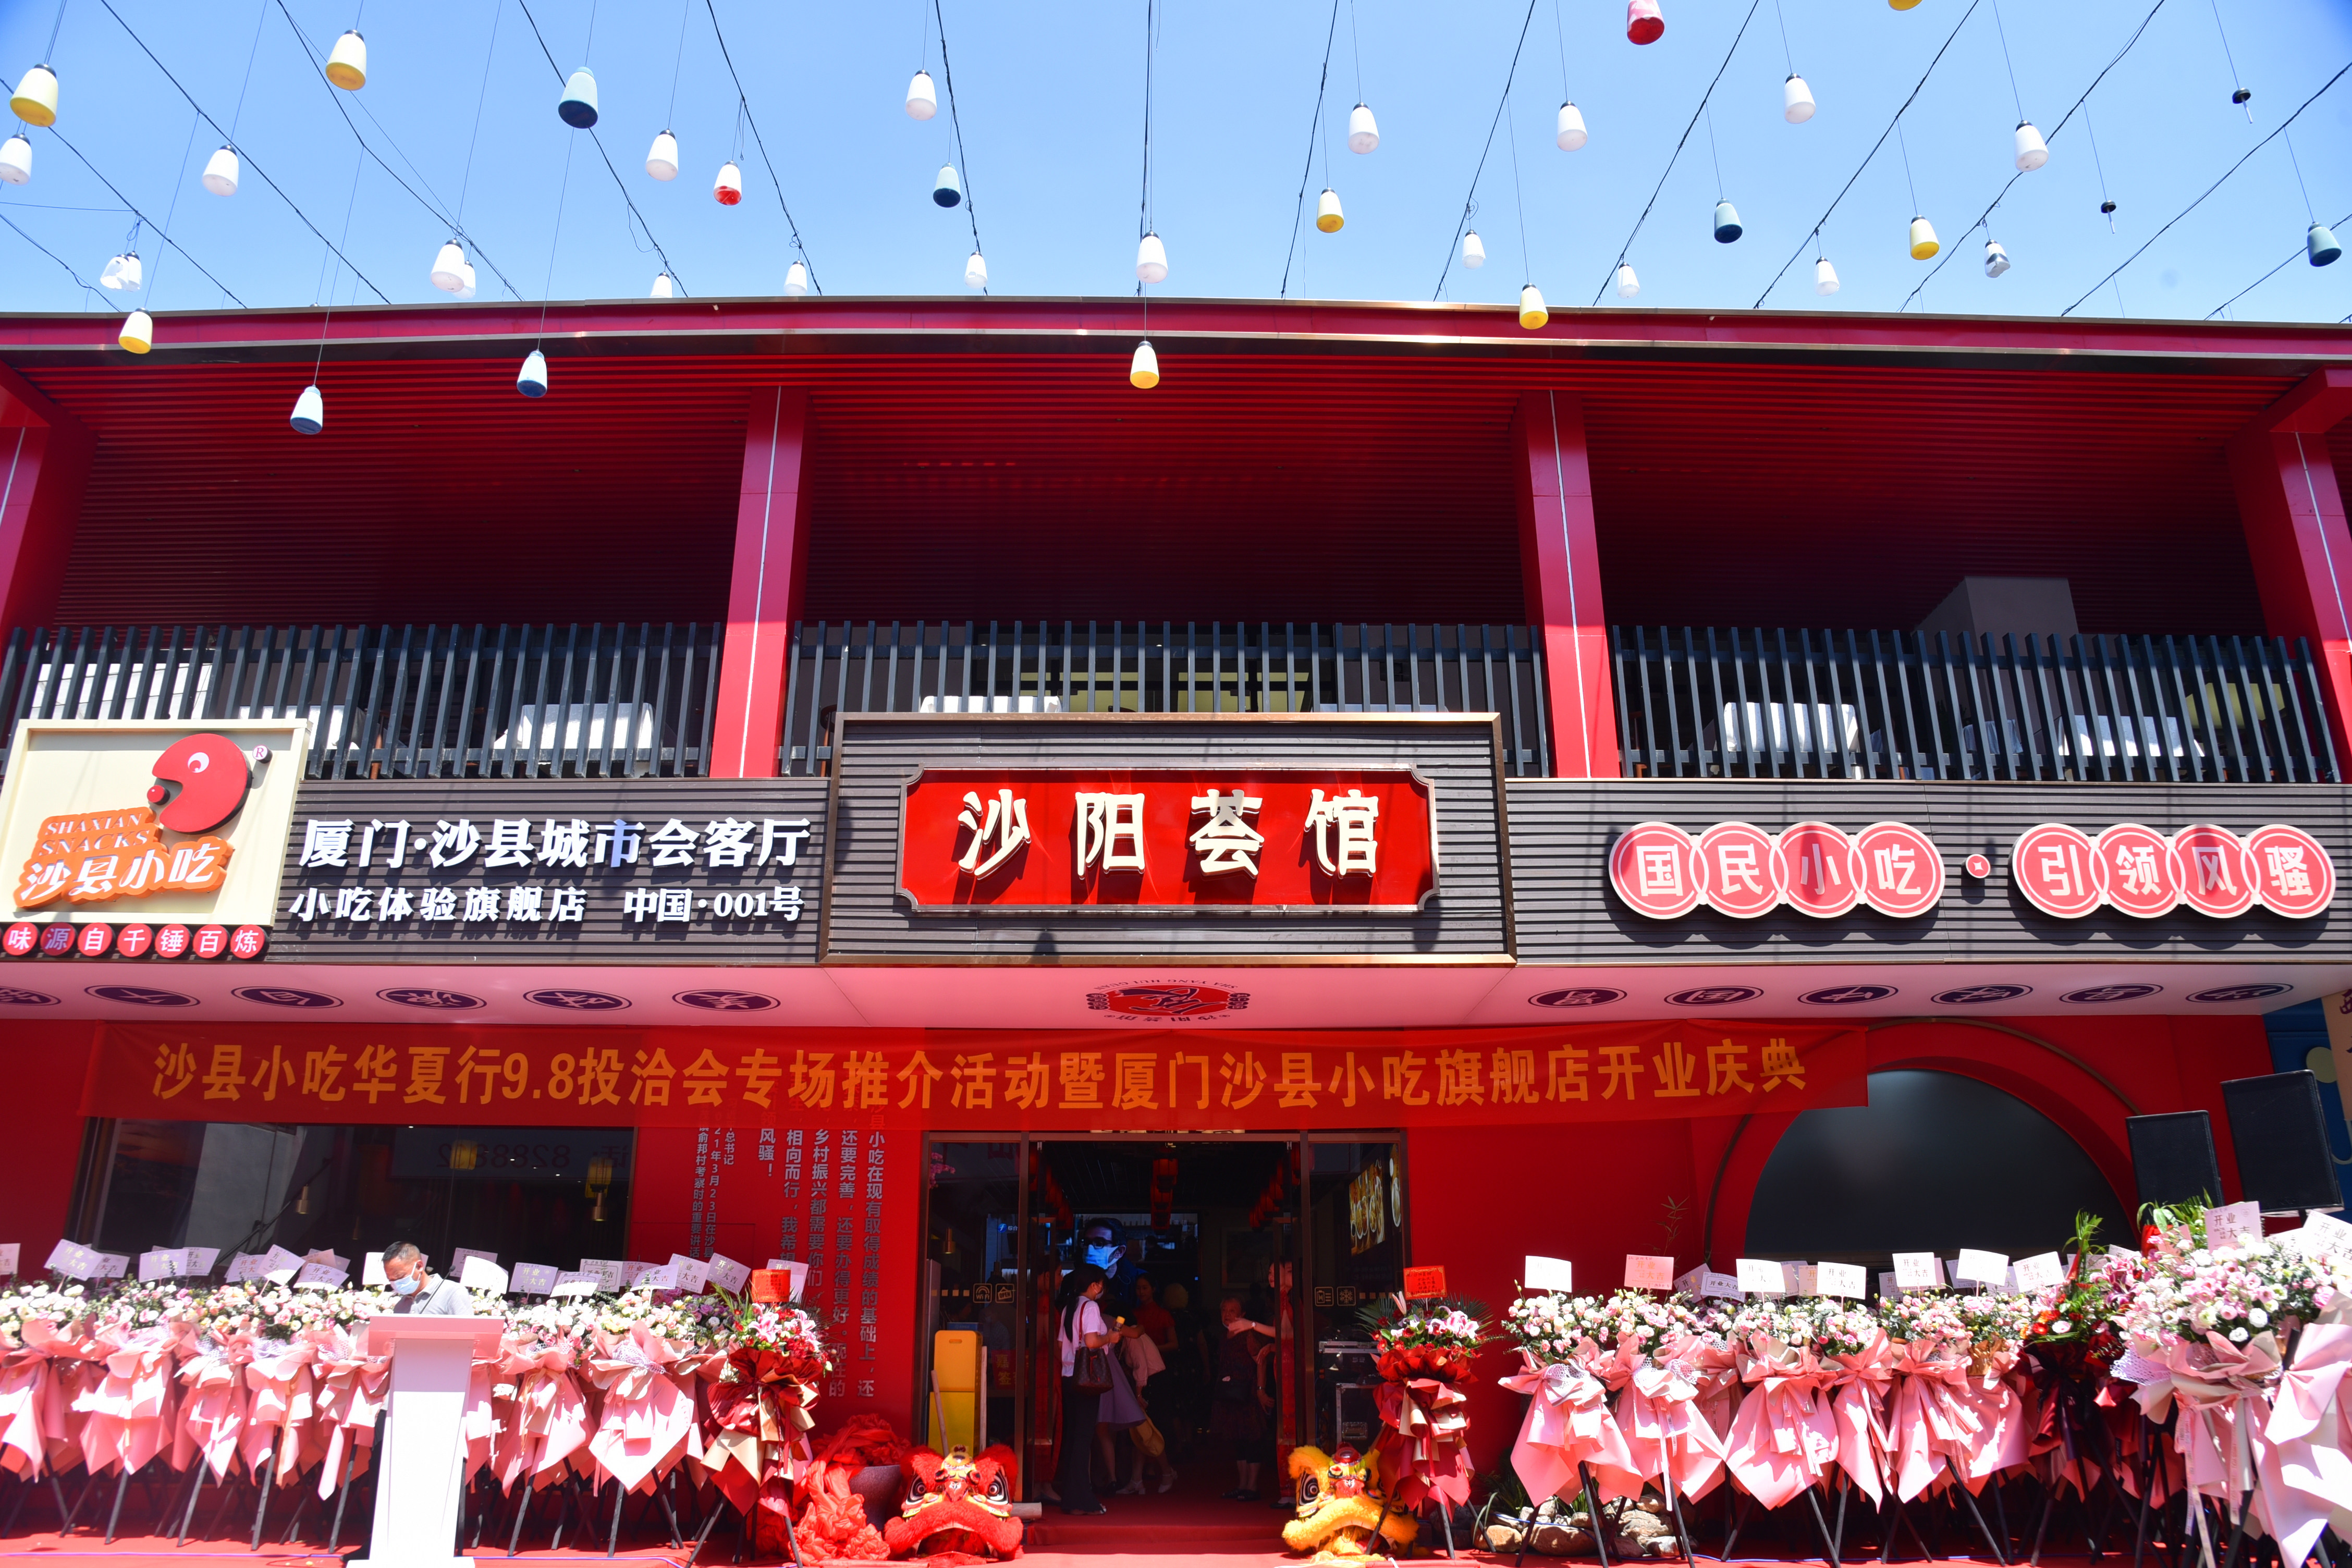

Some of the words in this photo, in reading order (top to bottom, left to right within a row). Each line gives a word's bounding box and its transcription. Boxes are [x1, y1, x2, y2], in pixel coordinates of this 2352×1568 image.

[43, 812, 144, 836] SHAXIAN
[957, 787, 1380, 881] 沙阳荟馆
[38, 830, 150, 857] SNACKS
[299, 816, 812, 869] 厦门·沙县城市会客厅
[20, 842, 215, 901] 沙县小吃
[1636, 843, 1922, 900] 国民小吃
[2039, 843, 2316, 900] 引领风骚
[288, 886, 588, 923] 小吃体验旗舰店
[7, 926, 260, 954] 味源自千锤百炼
[153, 1037, 1806, 1110] 沙县小吃华夏行9.8投洽会专场推介活动暨厦门沙县小吃旗舰店开业庆典
[2214, 1212, 2237, 1227] 开业
[2319, 1222, 2347, 1241] 开业
[2326, 1242, 2352, 1260] 大吉
[522, 1267, 541, 1276] 开业
[717, 1259, 734, 1272] 开业
[1636, 1260, 1656, 1269] 开业
[1829, 1268, 1846, 1277] 开业
[2023, 1261, 2040, 1272] 开业
[682, 1272, 699, 1283] 大吉
[722, 1272, 739, 1284] 大吉
[1646, 1271, 1664, 1281] 大吉
[1914, 1269, 1928, 1277] 大吉
[529, 1278, 547, 1287] 大吉
[1840, 1280, 1856, 1289] 大吉
